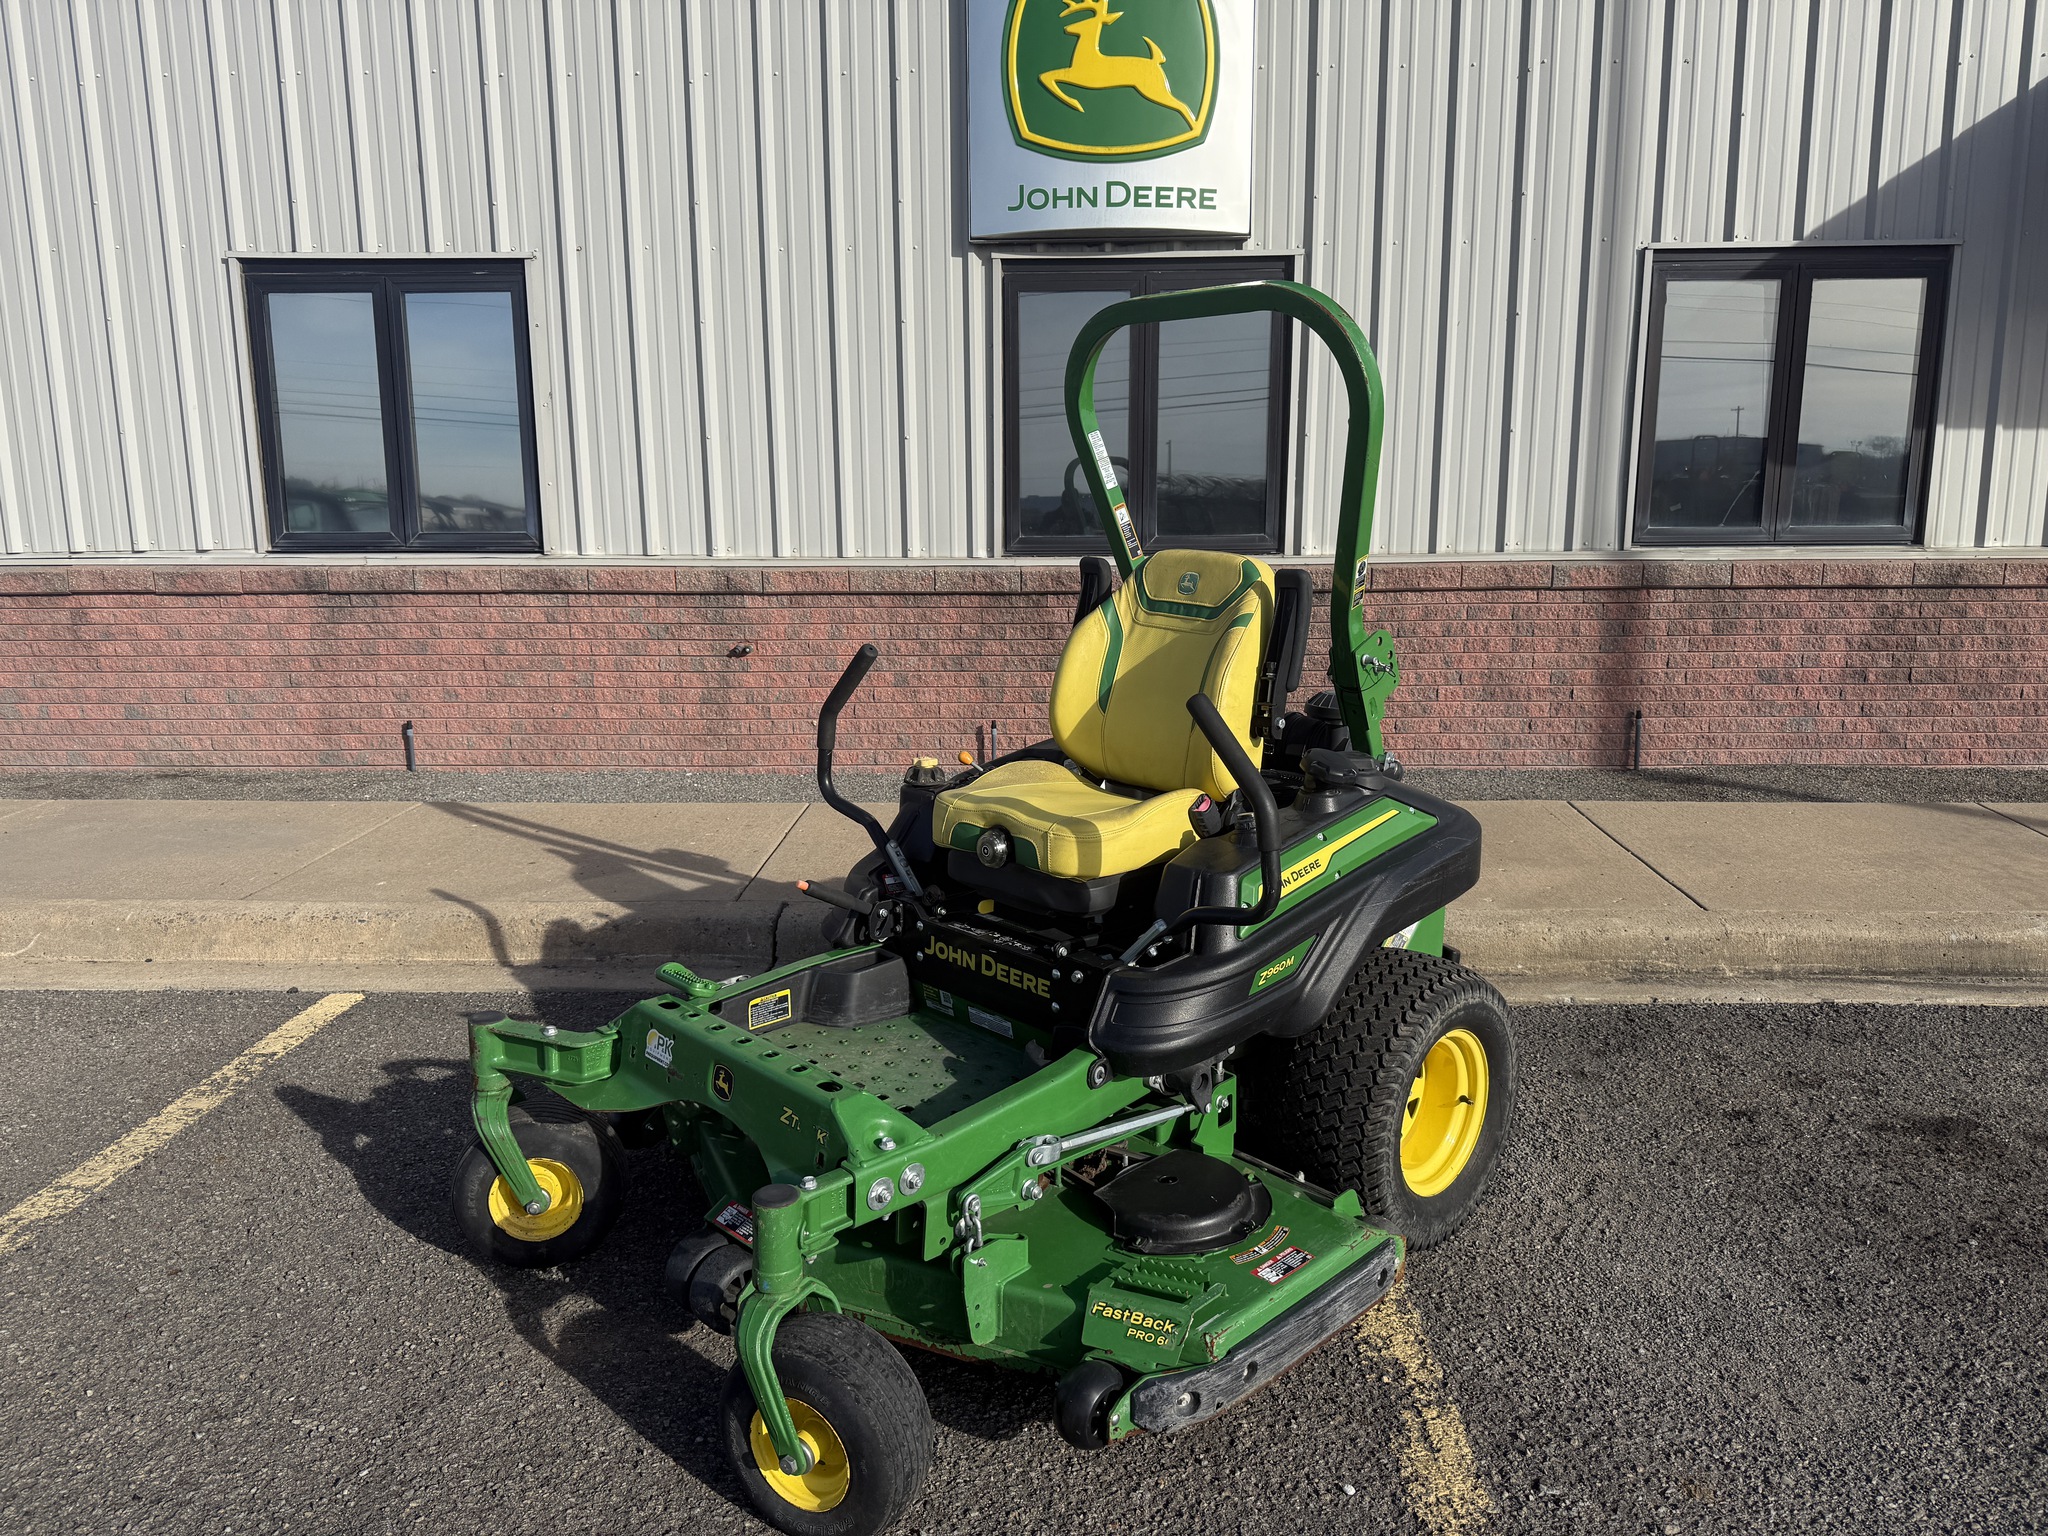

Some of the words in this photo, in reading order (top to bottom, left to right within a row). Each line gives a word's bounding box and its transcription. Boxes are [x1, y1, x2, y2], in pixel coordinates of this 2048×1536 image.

[1007, 184, 1098, 212] JOHN
[1105, 180, 1218, 210] DEERE
[1290, 858, 1322, 882] DEERE
[924, 935, 976, 972] JOHN
[981, 953, 1051, 999] DEERE
[1257, 955, 1295, 987] Z960M
[1090, 1301, 1176, 1334] FastBack
[1126, 1327, 1155, 1343] PRO
